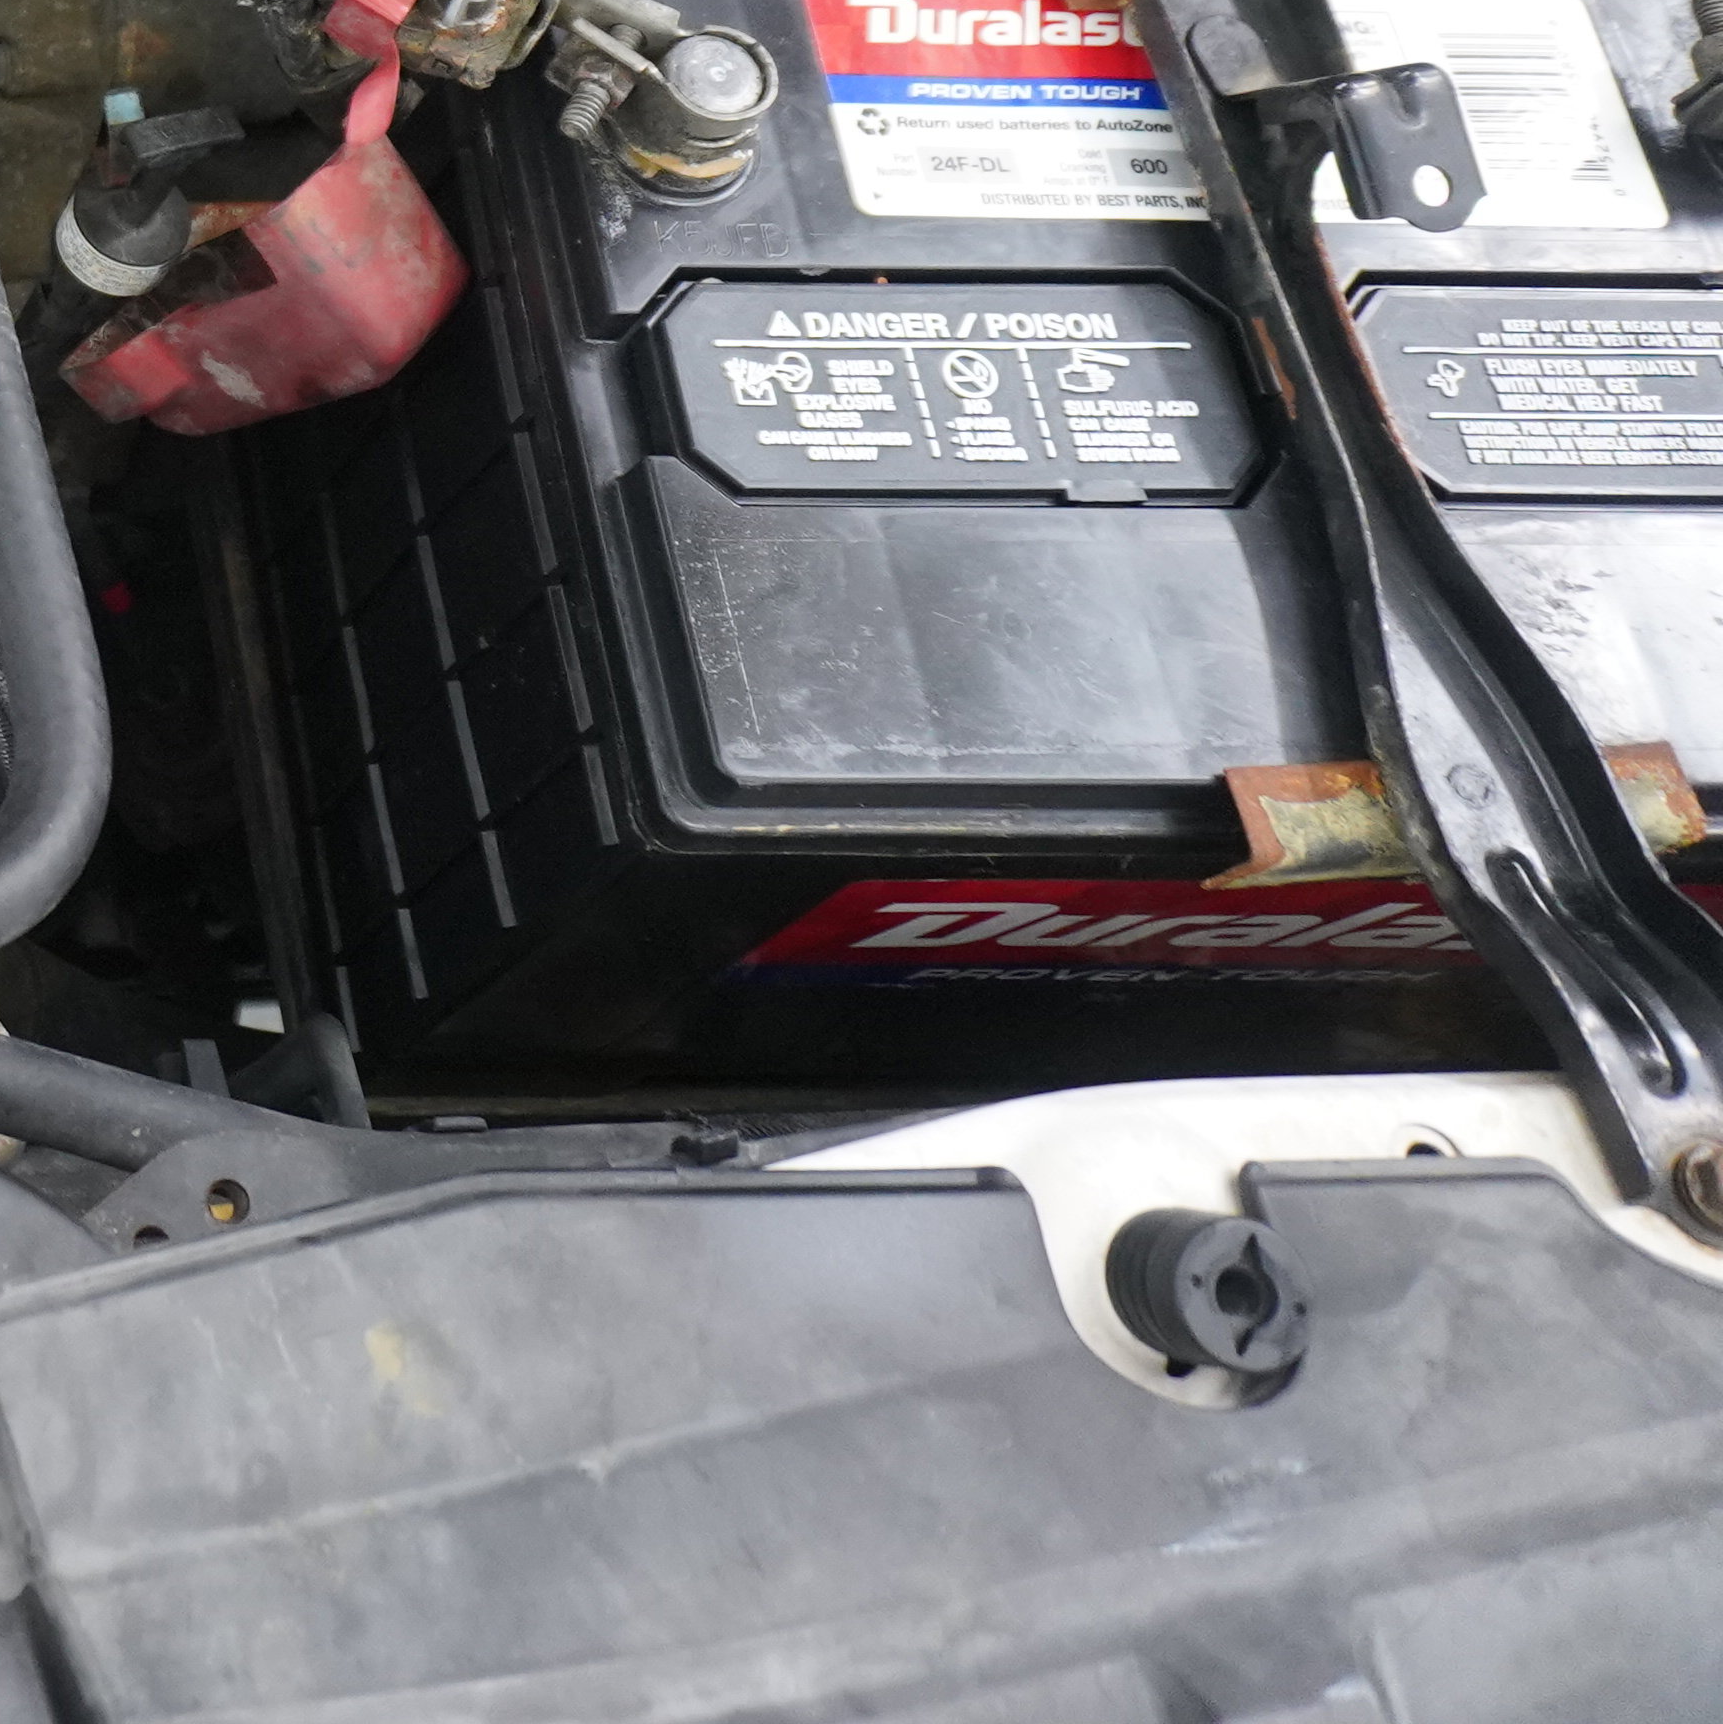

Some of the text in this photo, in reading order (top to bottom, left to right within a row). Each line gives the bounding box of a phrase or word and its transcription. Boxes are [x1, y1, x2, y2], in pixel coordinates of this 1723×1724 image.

[909, 82, 1142, 101] PROVEN TOUGH
[897, 116, 1174, 134] Return used batteries to AutoZone
[930, 155, 1012, 173] 24F-DL
[1130, 157, 1169, 175] 600
[980, 193, 1071, 207] DISTRIBUTED
[1075, 194, 1093, 206] BY
[1097, 194, 1132, 207] BEST
[1135, 195, 1184, 210] PARTS,
[801, 311, 951, 339] DANGER
[983, 312, 1119, 340] POISON
[825, 359, 895, 376] SHIELD
[1483, 358, 1698, 377] FLUSH EYES IMMEDIATELY
[830, 377, 883, 393] EYES
[1490, 377, 1539, 394] WITH
[1605, 378, 1640, 394] GET
[793, 394, 897, 411] EXPLOSIVE
[962, 398, 994, 415] NO
[1062, 399, 1200, 417] SULFURIC ACID
[1497, 394, 1664, 412] MEDICAL HELP FAST
[799, 412, 864, 429] GASES
